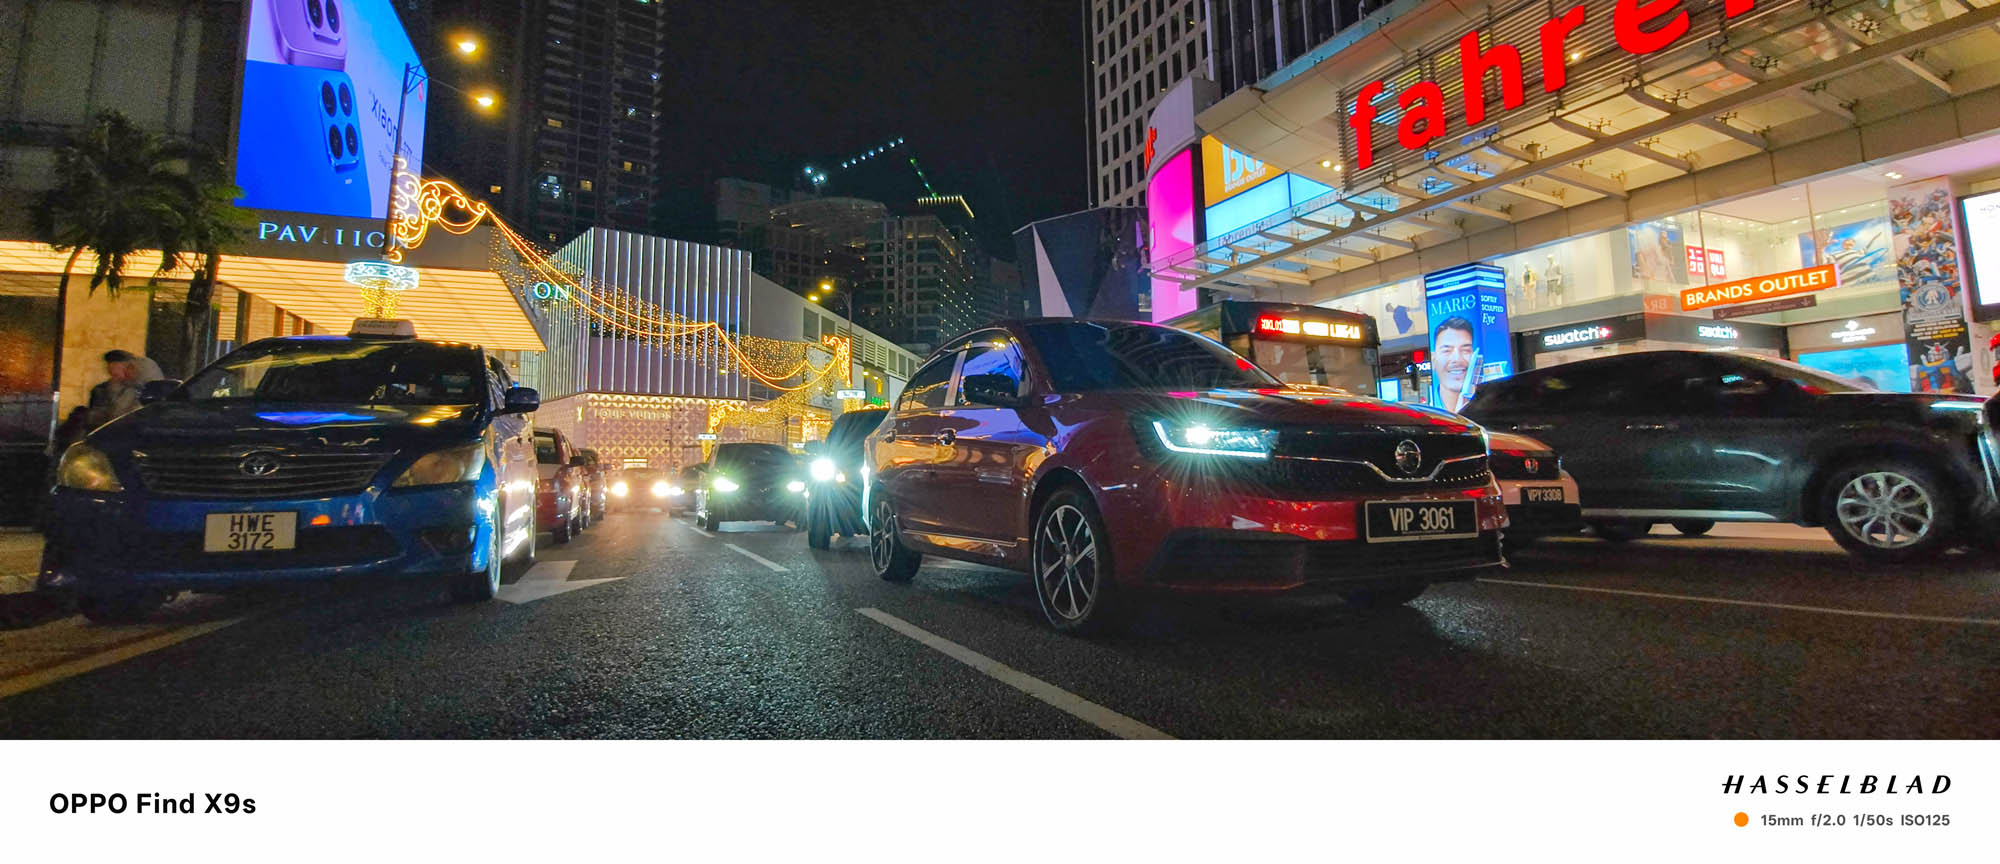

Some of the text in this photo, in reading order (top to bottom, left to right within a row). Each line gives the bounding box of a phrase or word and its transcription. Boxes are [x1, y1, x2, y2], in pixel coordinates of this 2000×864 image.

[1350, 0, 1753, 169] fahre
[1686, 270, 1829, 306] BRANDS OUTLET
[1431, 294, 1477, 317] MARIO
[1482, 313, 1496, 325] Eye
[230, 514, 275, 532] HWE
[1389, 507, 1454, 531] VIP 3061
[228, 532, 274, 549] 3172
